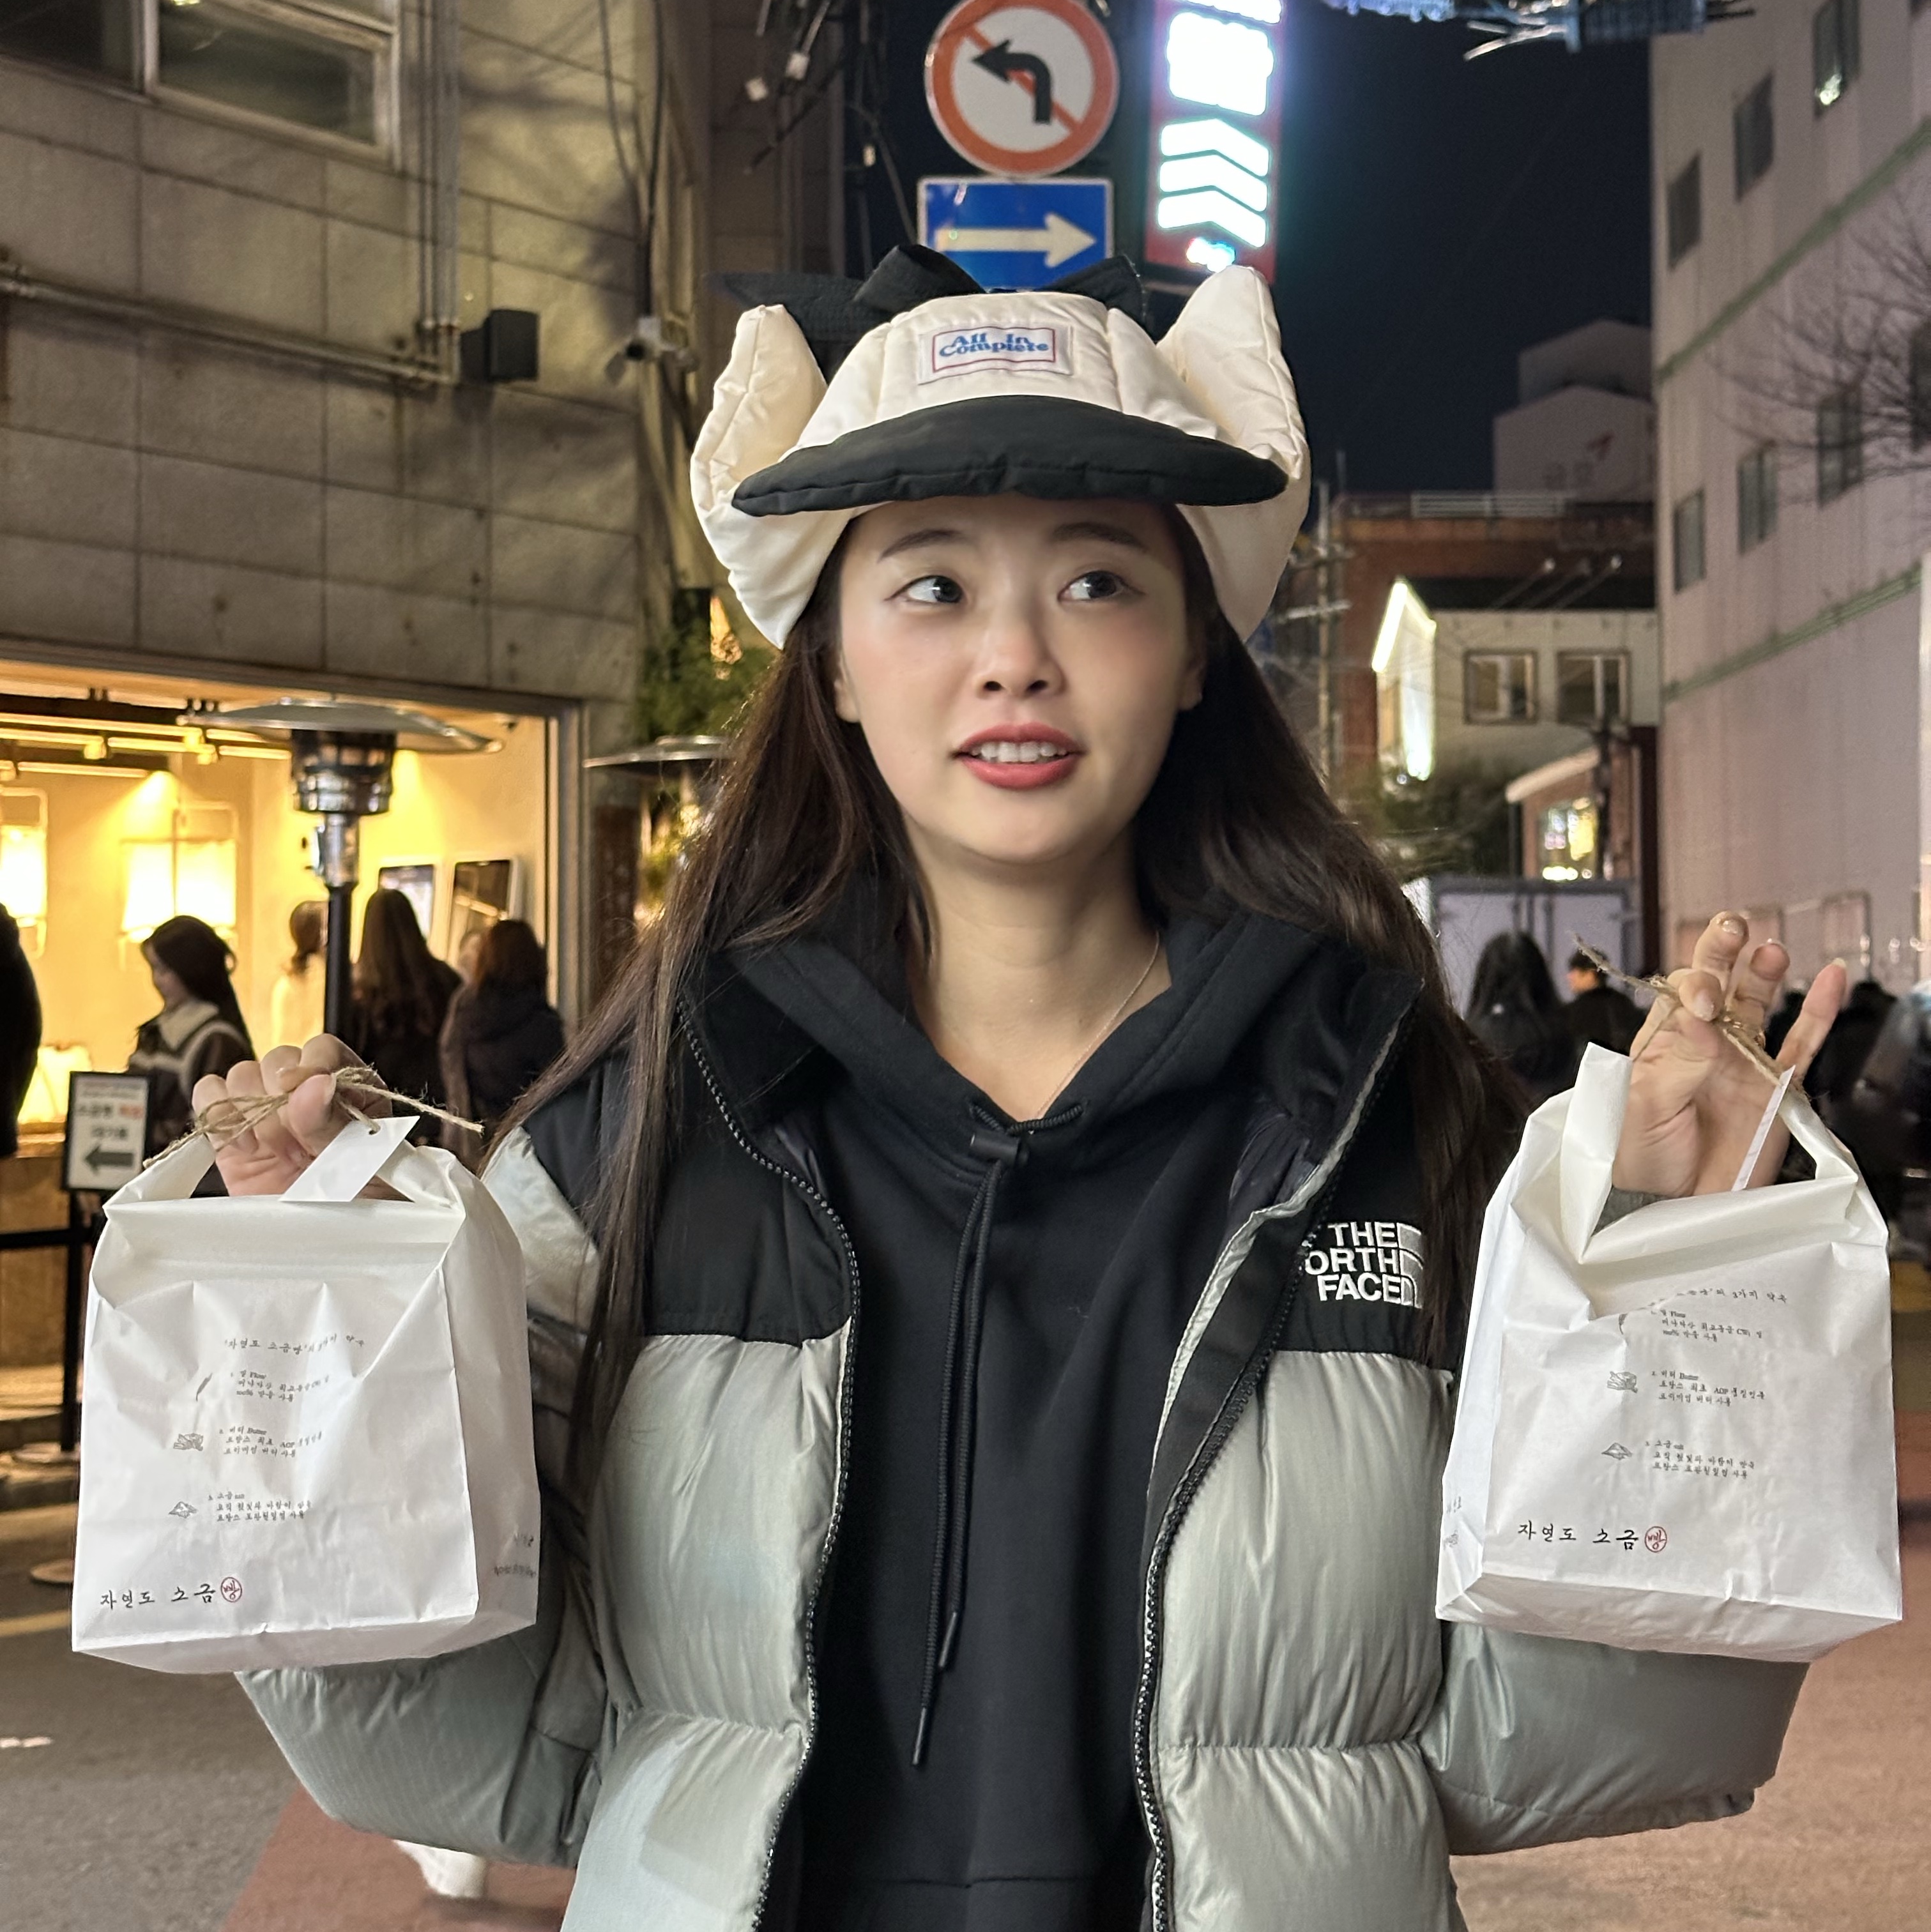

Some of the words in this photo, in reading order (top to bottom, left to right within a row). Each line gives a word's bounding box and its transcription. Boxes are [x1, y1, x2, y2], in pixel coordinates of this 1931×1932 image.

[940, 341, 1049, 357] Complete
[951, 333, 987, 345] All
[1327, 1222, 1398, 1247] THE
[1304, 1248, 1400, 1275] ORTH
[1317, 1272, 1401, 1304] FACE
[1518, 1521, 1576, 1542] 자연도
[100, 1590, 155, 1610] 자연도
